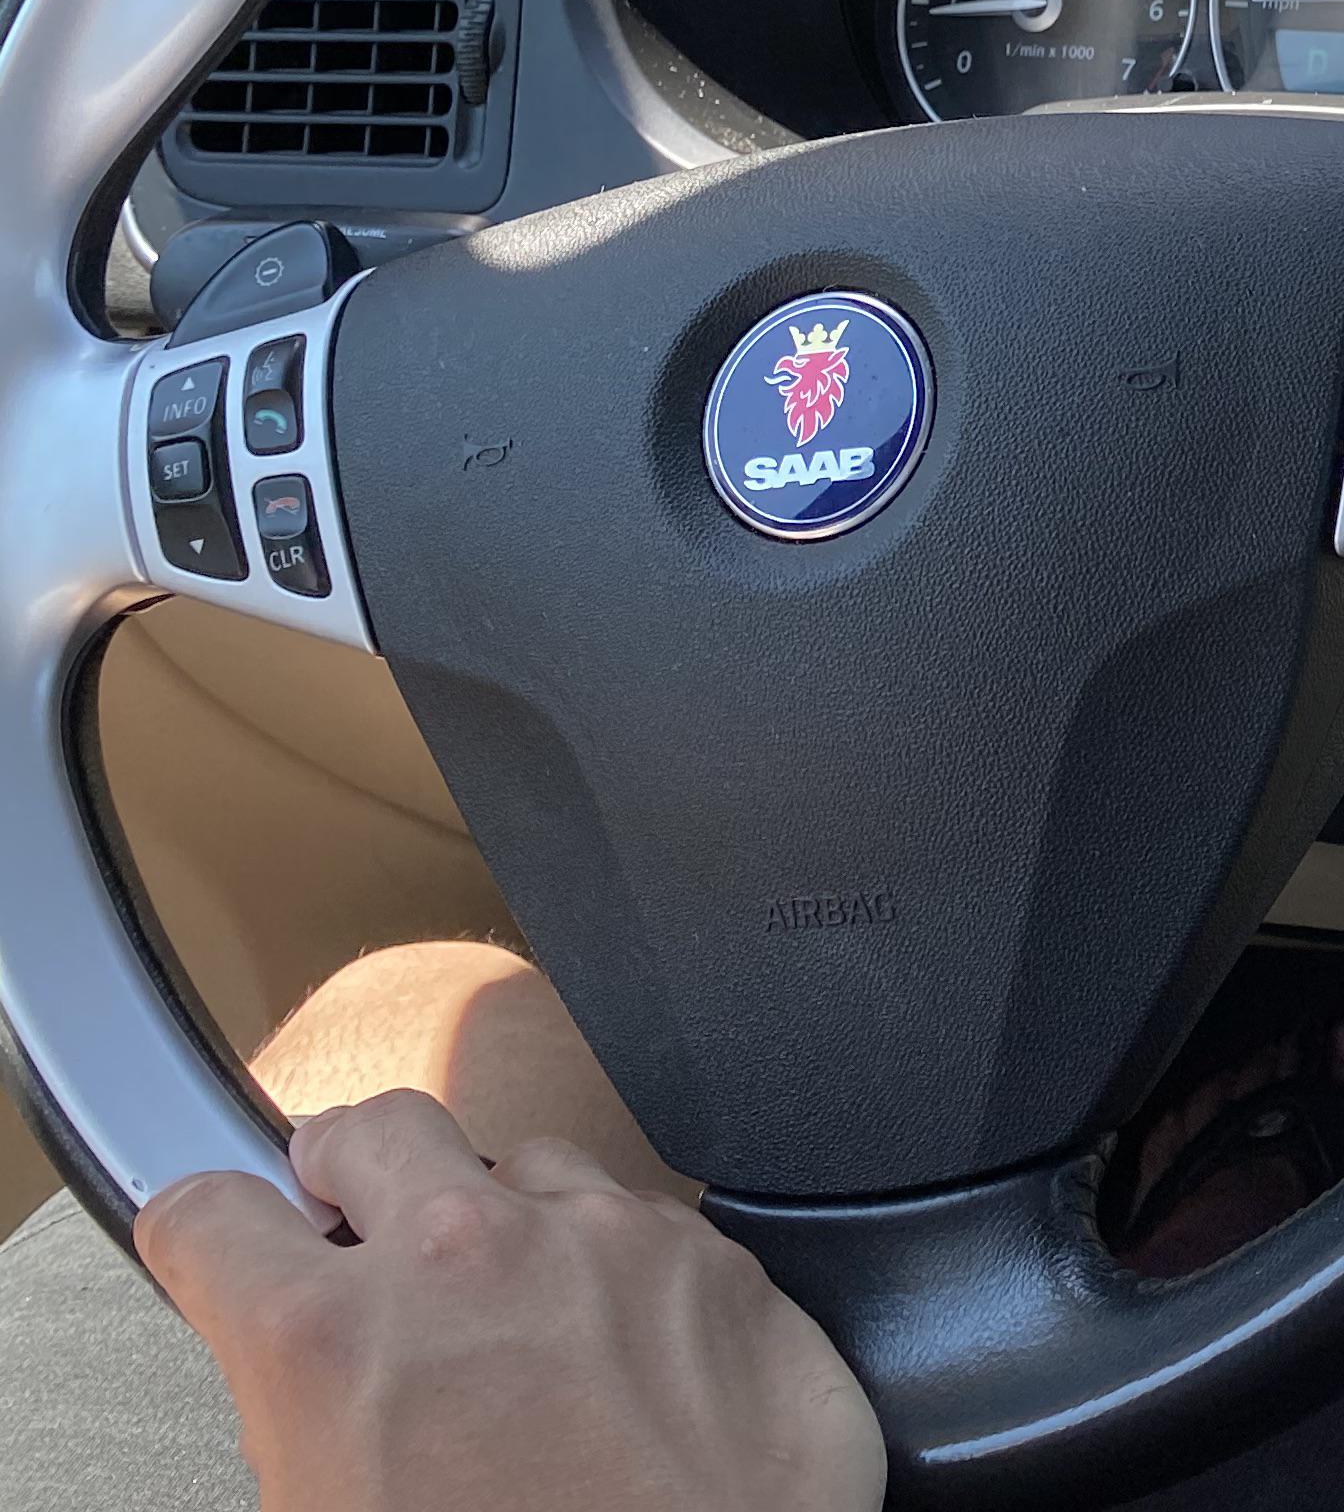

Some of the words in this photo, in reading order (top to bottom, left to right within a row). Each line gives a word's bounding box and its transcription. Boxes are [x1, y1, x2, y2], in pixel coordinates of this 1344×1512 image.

[1149, 0, 1164, 21] 6
[957, 51, 973, 73] 0
[1061, 45, 1095, 60] 1000
[1121, 58, 1136, 80] 7
[163, 396, 207, 423] INFO
[163, 459, 190, 481] SET
[744, 446, 875, 492] SAAB
[269, 545, 305, 573] CLR
[767, 890, 897, 933] AIRBAG
